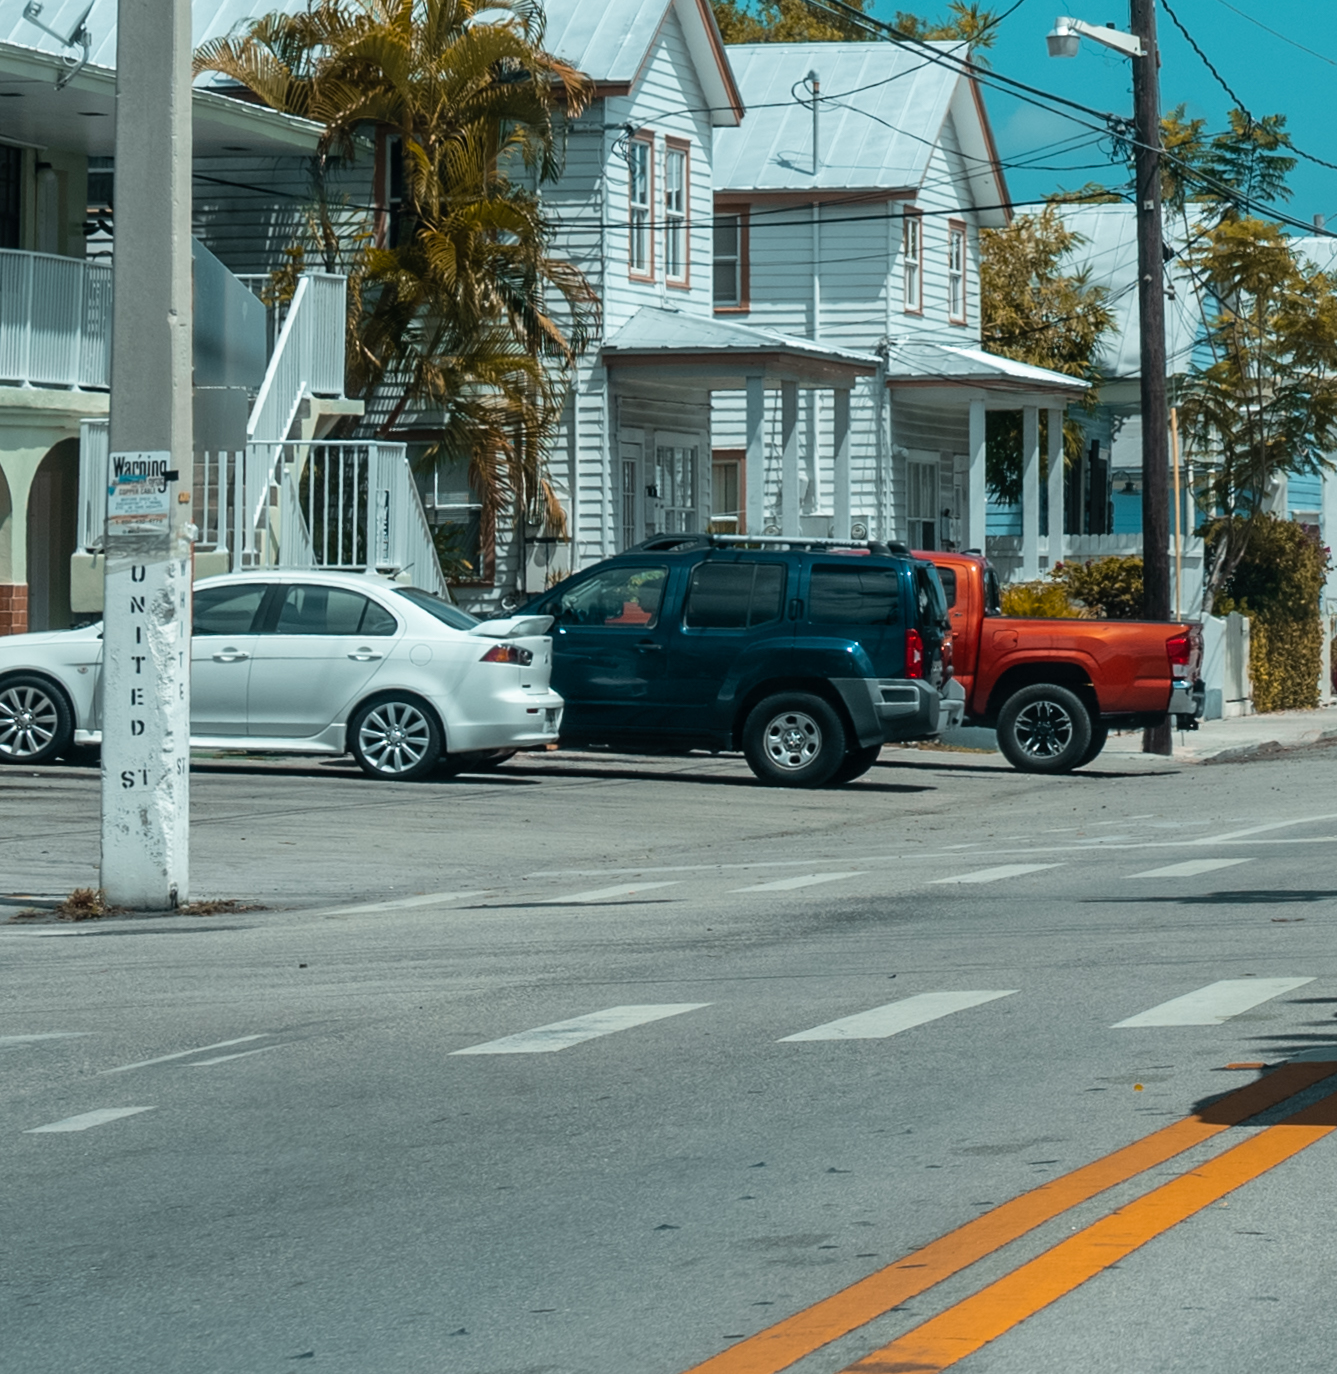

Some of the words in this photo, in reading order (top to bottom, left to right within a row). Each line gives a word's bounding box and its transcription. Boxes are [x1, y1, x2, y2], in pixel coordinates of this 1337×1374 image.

[113, 454, 167, 493] Warning
[130, 565, 146, 736] UNITED
[121, 769, 151, 789] ST
[176, 757, 186, 776] ST
